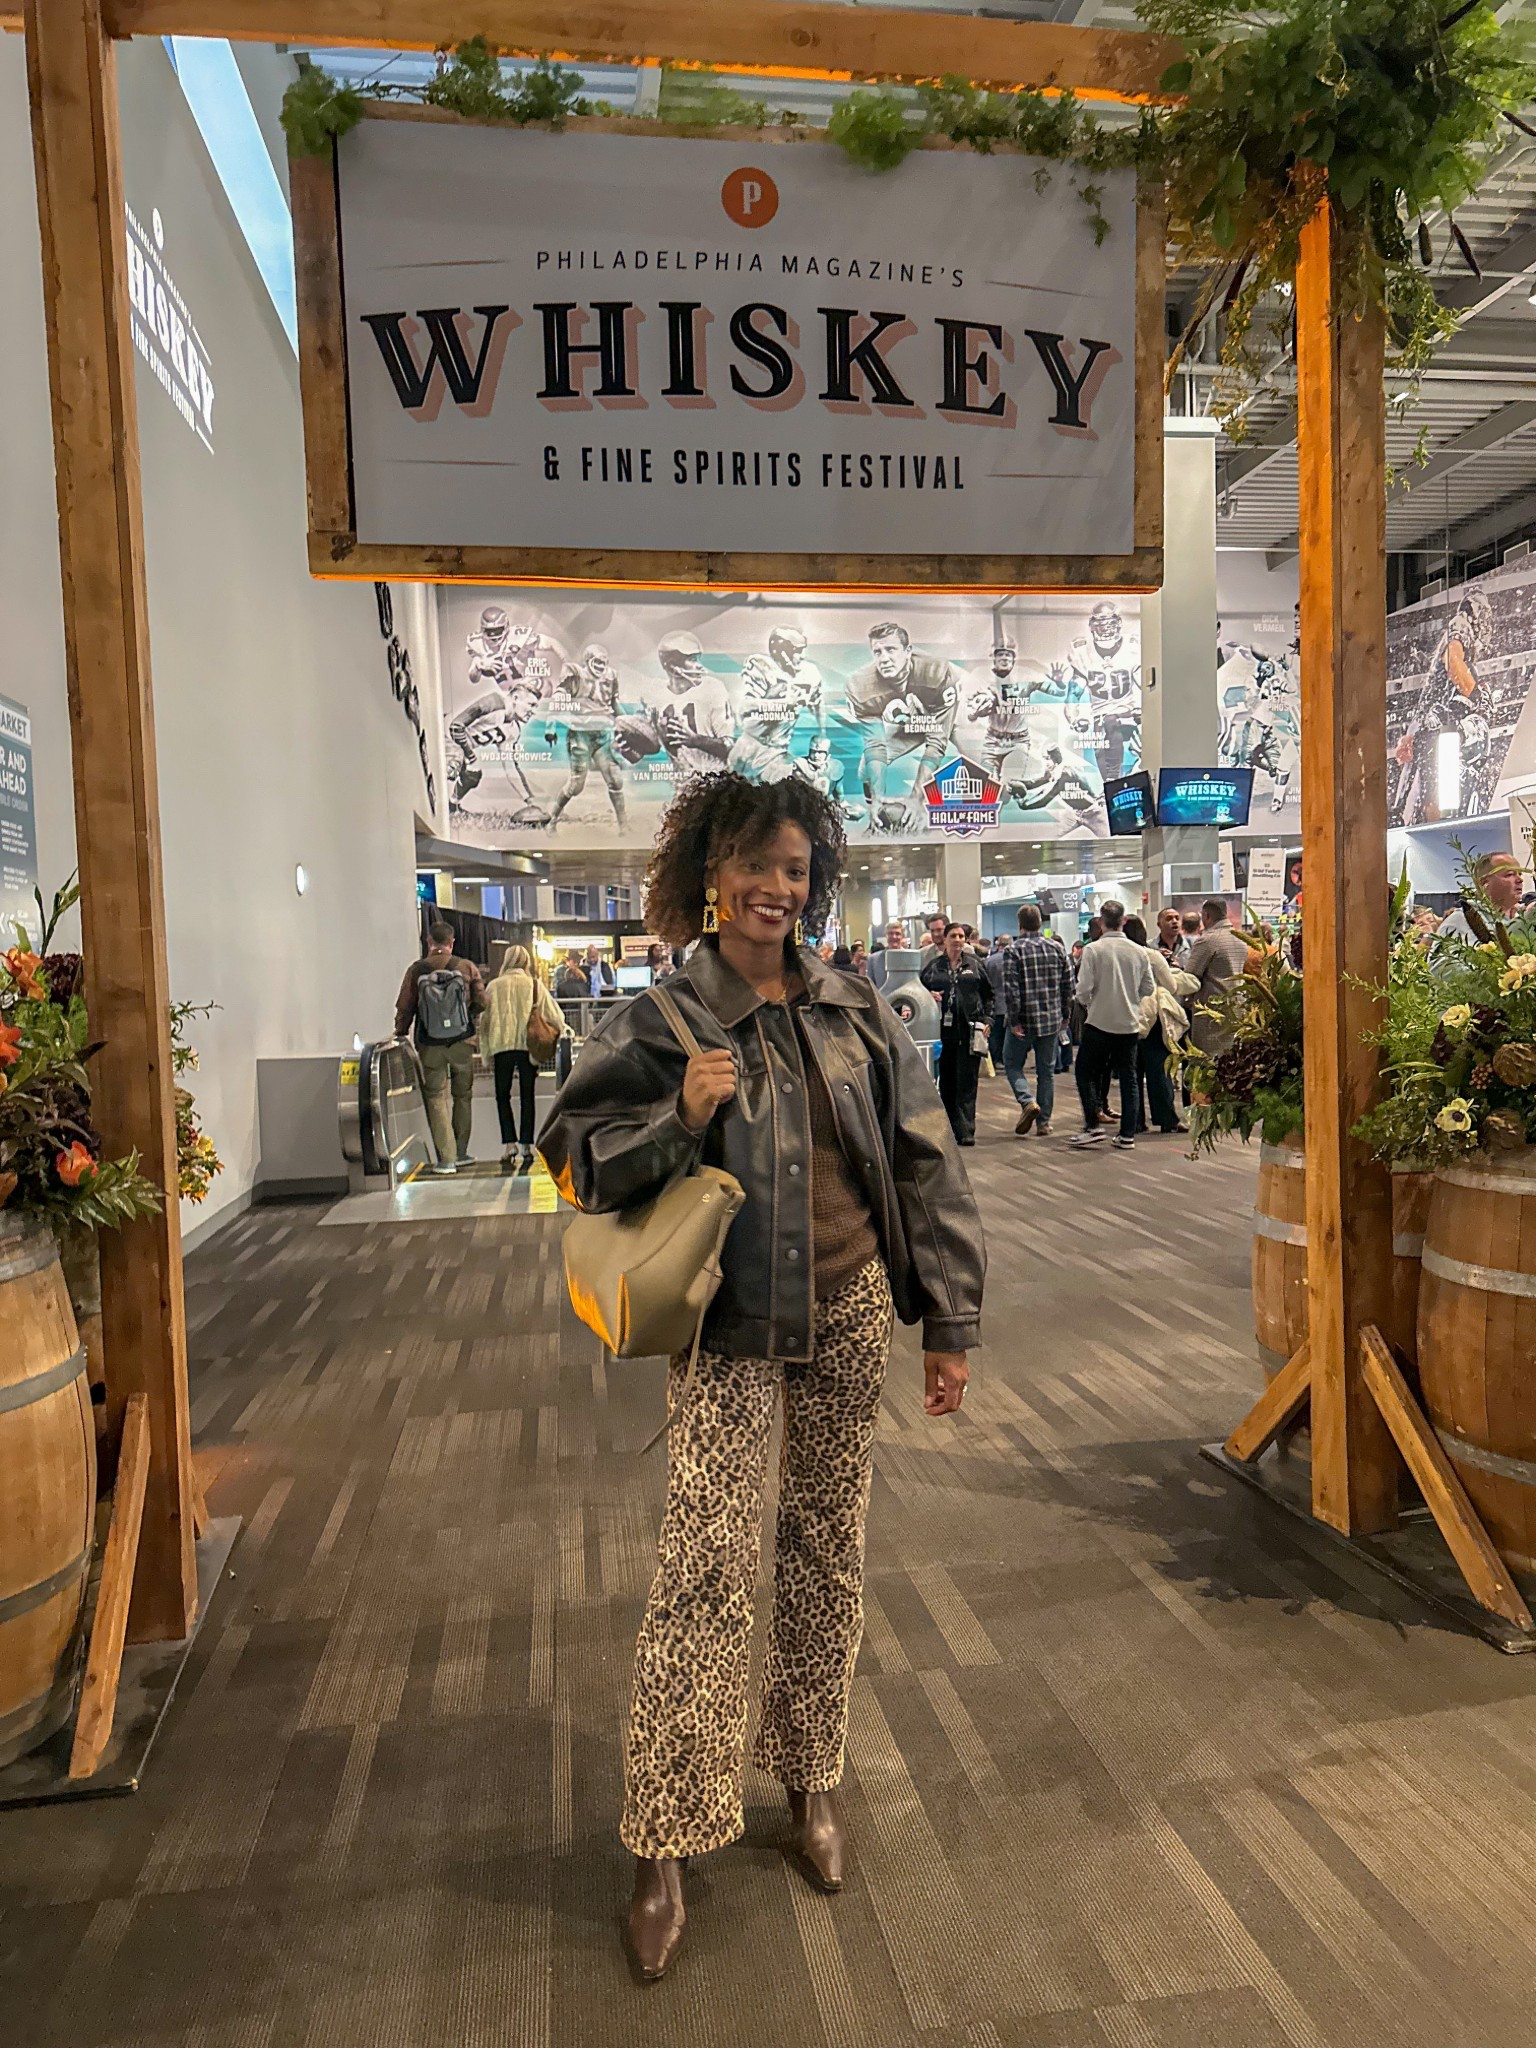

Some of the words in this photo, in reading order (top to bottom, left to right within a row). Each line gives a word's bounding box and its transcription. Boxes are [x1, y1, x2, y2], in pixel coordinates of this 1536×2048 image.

[536, 249, 764, 273] PHILADELPHIA
[780, 254, 966, 288] MAGAZINE'S
[126, 229, 215, 435] HISKEY
[360, 300, 1116, 430] WHISKEY
[543, 445, 560, 481] &
[581, 448, 654, 484] FINE
[673, 449, 802, 488] SPIRITS
[822, 453, 966, 491] FESTIVAL
[1261, 615, 1280, 623] DICK
[1253, 624, 1286, 633] VERMEIL
[527, 658, 547, 667] ERIC
[524, 667, 551, 676] ALLEN
[1006, 698, 1030, 706] STEVE
[1268, 695, 1286, 703] PETE
[549, 702, 581, 711] BROWN
[759, 703, 788, 712] TOMMY
[996, 706, 1014, 714] VAN
[1015, 706, 1041, 714] BUREN
[750, 712, 795, 721] McDONALD
[910, 715, 937, 724] CHUCK
[904, 724, 943, 733] BEDNARIK
[1078, 731, 1102, 741] BRIAN
[505, 744, 525, 752] ALEX
[1073, 740, 1110, 749] DAWKINS
[480, 752, 553, 761] WOJCIECHOWICZ
[8, 749, 27, 774] AND
[648, 763, 674, 772] NORM
[633, 773, 650, 781] VAN
[1065, 782, 1081, 791] BILL
[1175, 784, 1237, 797] WHISKEY
[1113, 790, 1143, 807] WHISKEY
[932, 811, 960, 824] HALL
[966, 811, 995, 823] FAME
